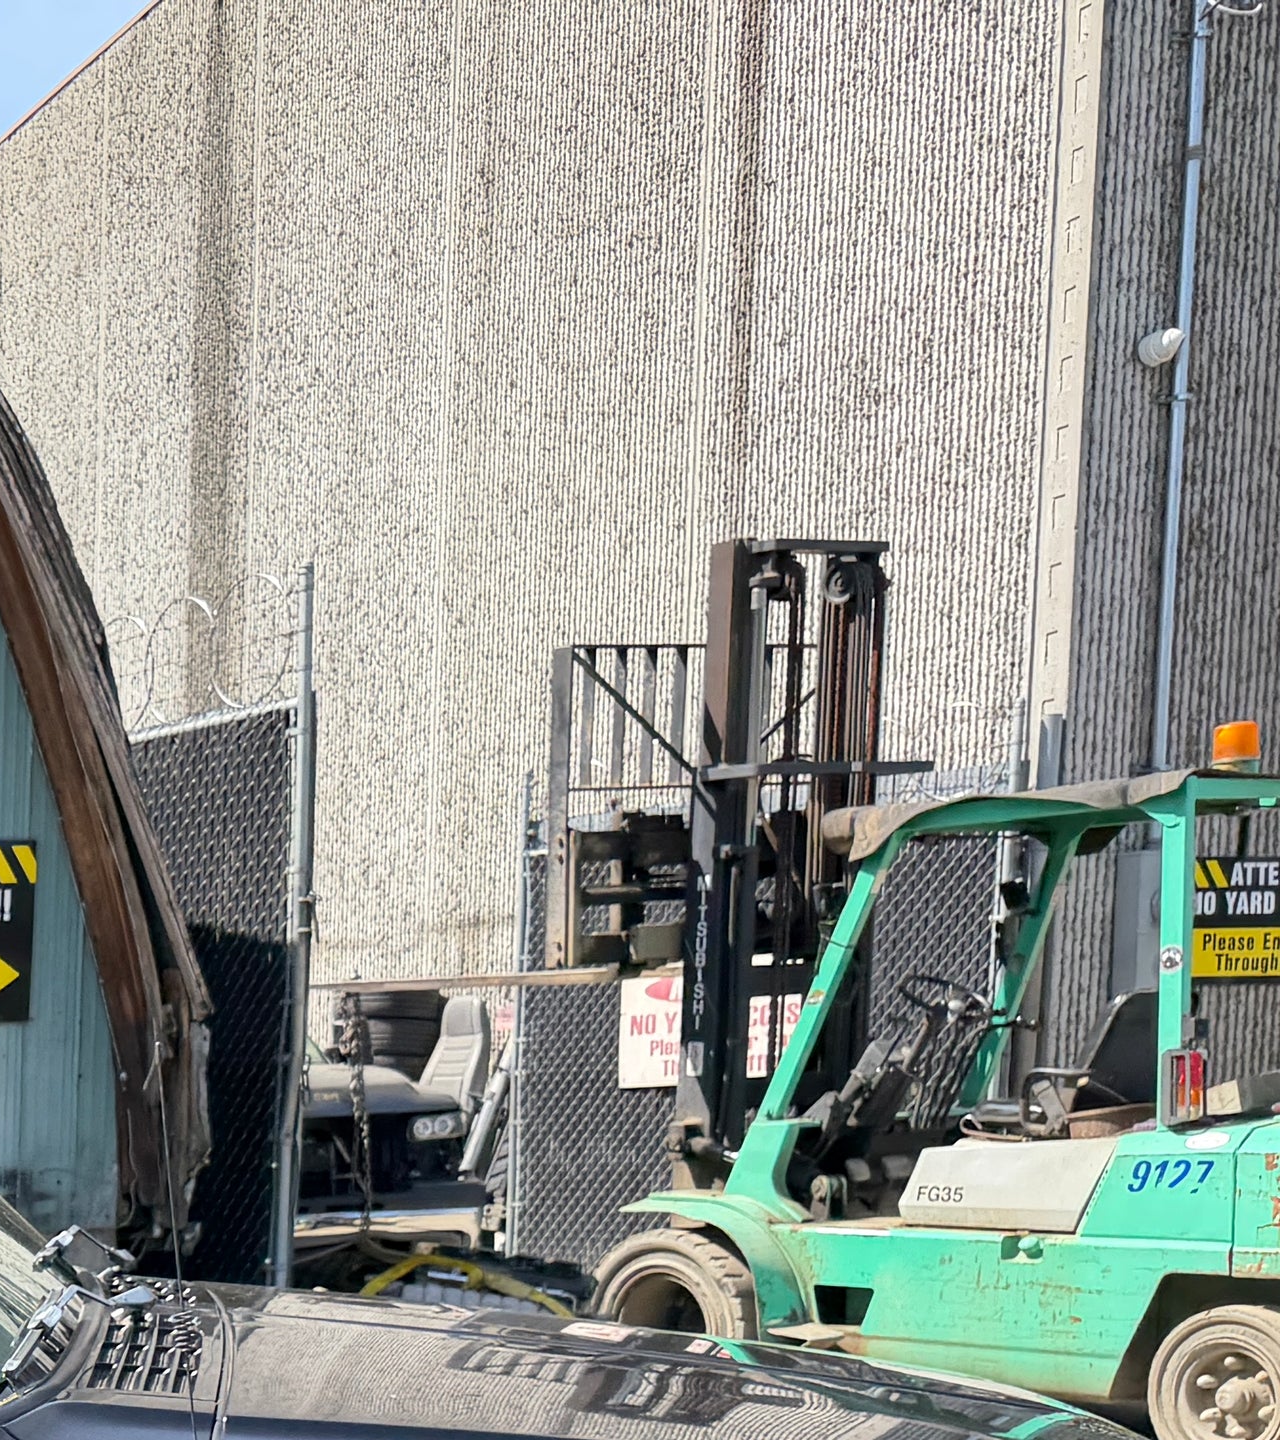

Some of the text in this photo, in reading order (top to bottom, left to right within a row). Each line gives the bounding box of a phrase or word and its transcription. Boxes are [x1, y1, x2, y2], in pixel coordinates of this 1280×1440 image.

[1225, 890, 1276, 915] YARD
[1202, 932, 1255, 952] Please
[1215, 952, 1279, 974] Through
[630, 1014, 657, 1037] NO
[1126, 1159, 1215, 1193] 9127
[916, 1185, 964, 1203] FG35
